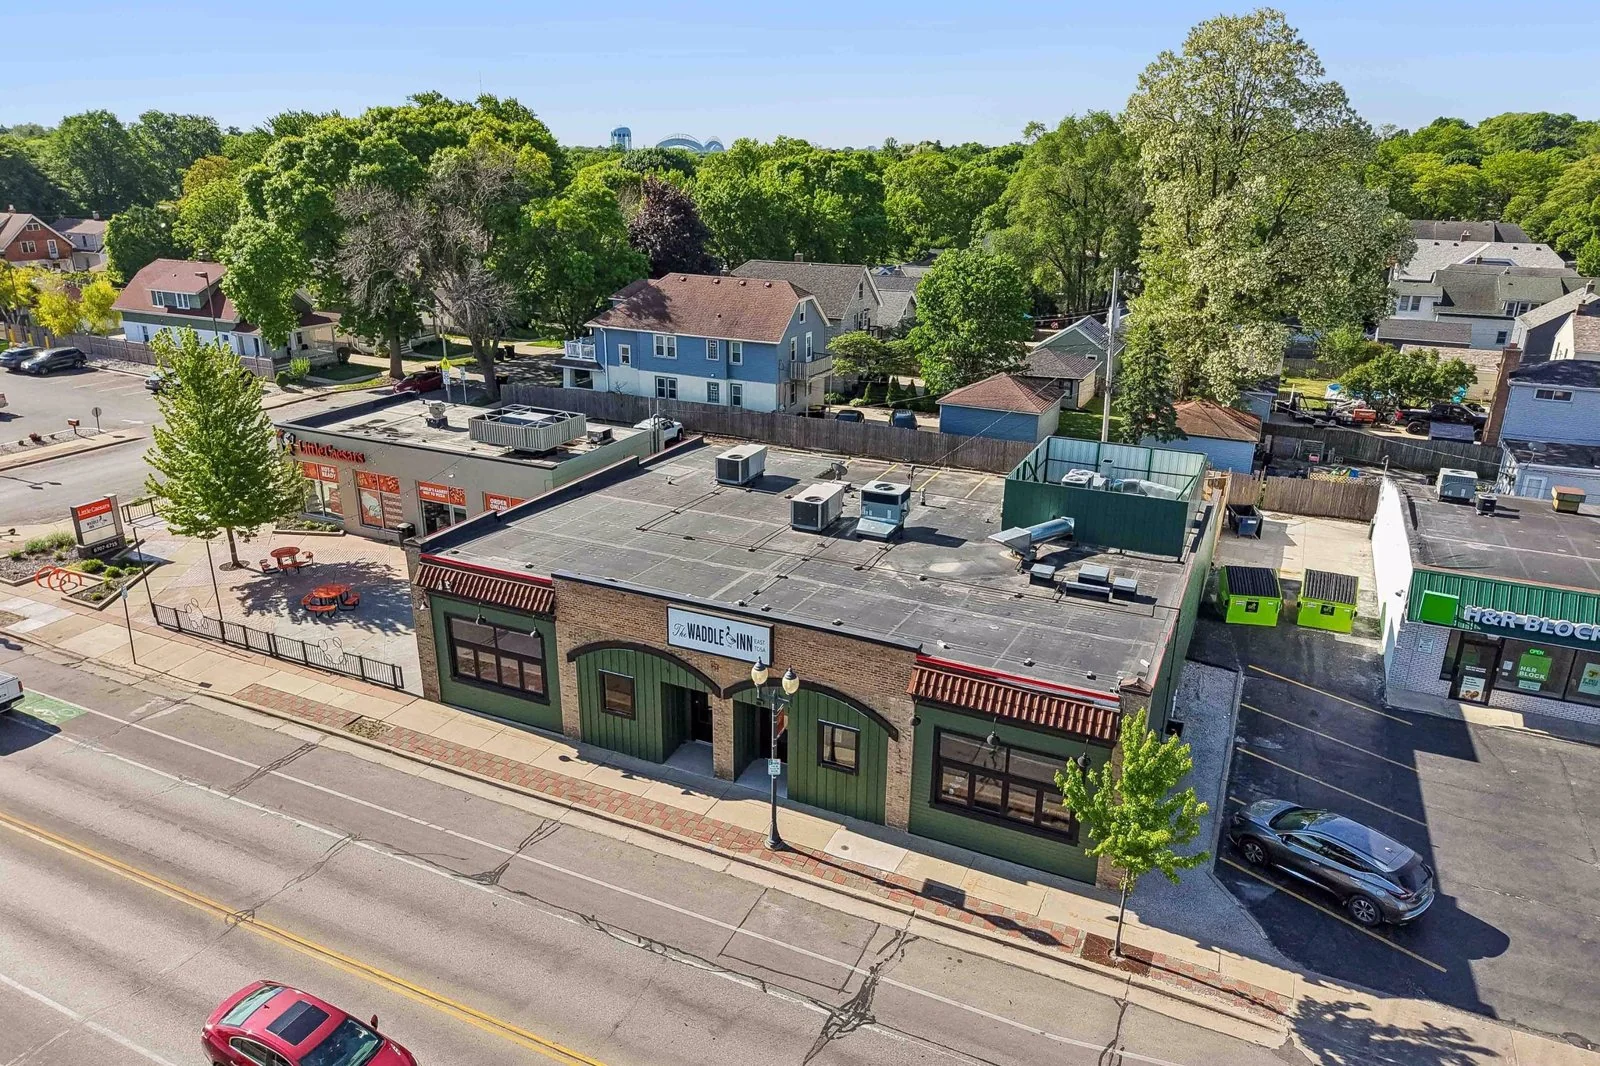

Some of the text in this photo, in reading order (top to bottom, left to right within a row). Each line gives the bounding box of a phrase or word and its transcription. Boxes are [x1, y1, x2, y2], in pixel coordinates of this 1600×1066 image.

[298, 439, 366, 463] Little Caesars
[490, 498, 507, 506] ORDER
[1463, 605, 1518, 628] H&R
[672, 622, 753, 652] The WADDLE INN
[754, 638, 766, 646] EAST
[1520, 665, 1537, 673] H&R
[1519, 670, 1546, 680] BLOCK
